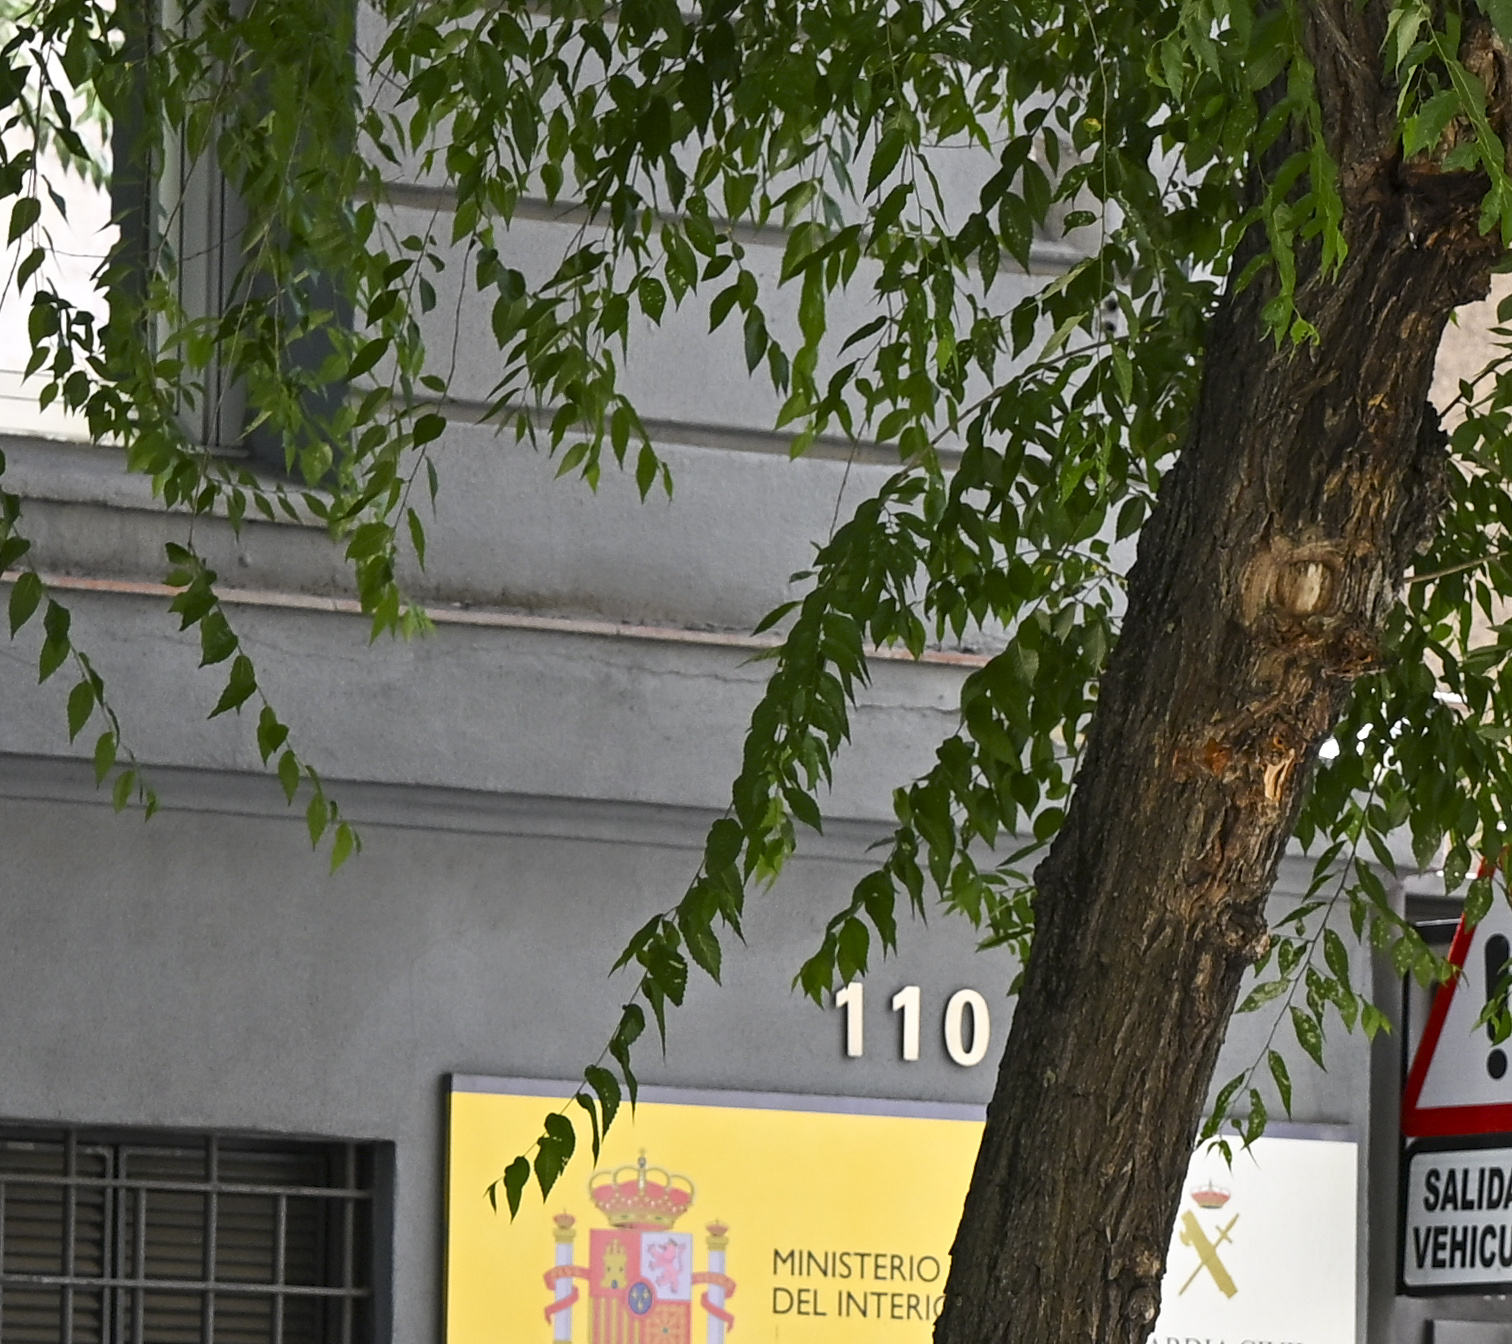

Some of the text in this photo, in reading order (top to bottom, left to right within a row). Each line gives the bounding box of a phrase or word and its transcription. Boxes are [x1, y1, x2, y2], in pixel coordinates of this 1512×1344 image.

[835, 982, 990, 1066] 110
[772, 1248, 941, 1283] MINISTERIO
[772, 1287, 946, 1321] DEL INTERI
